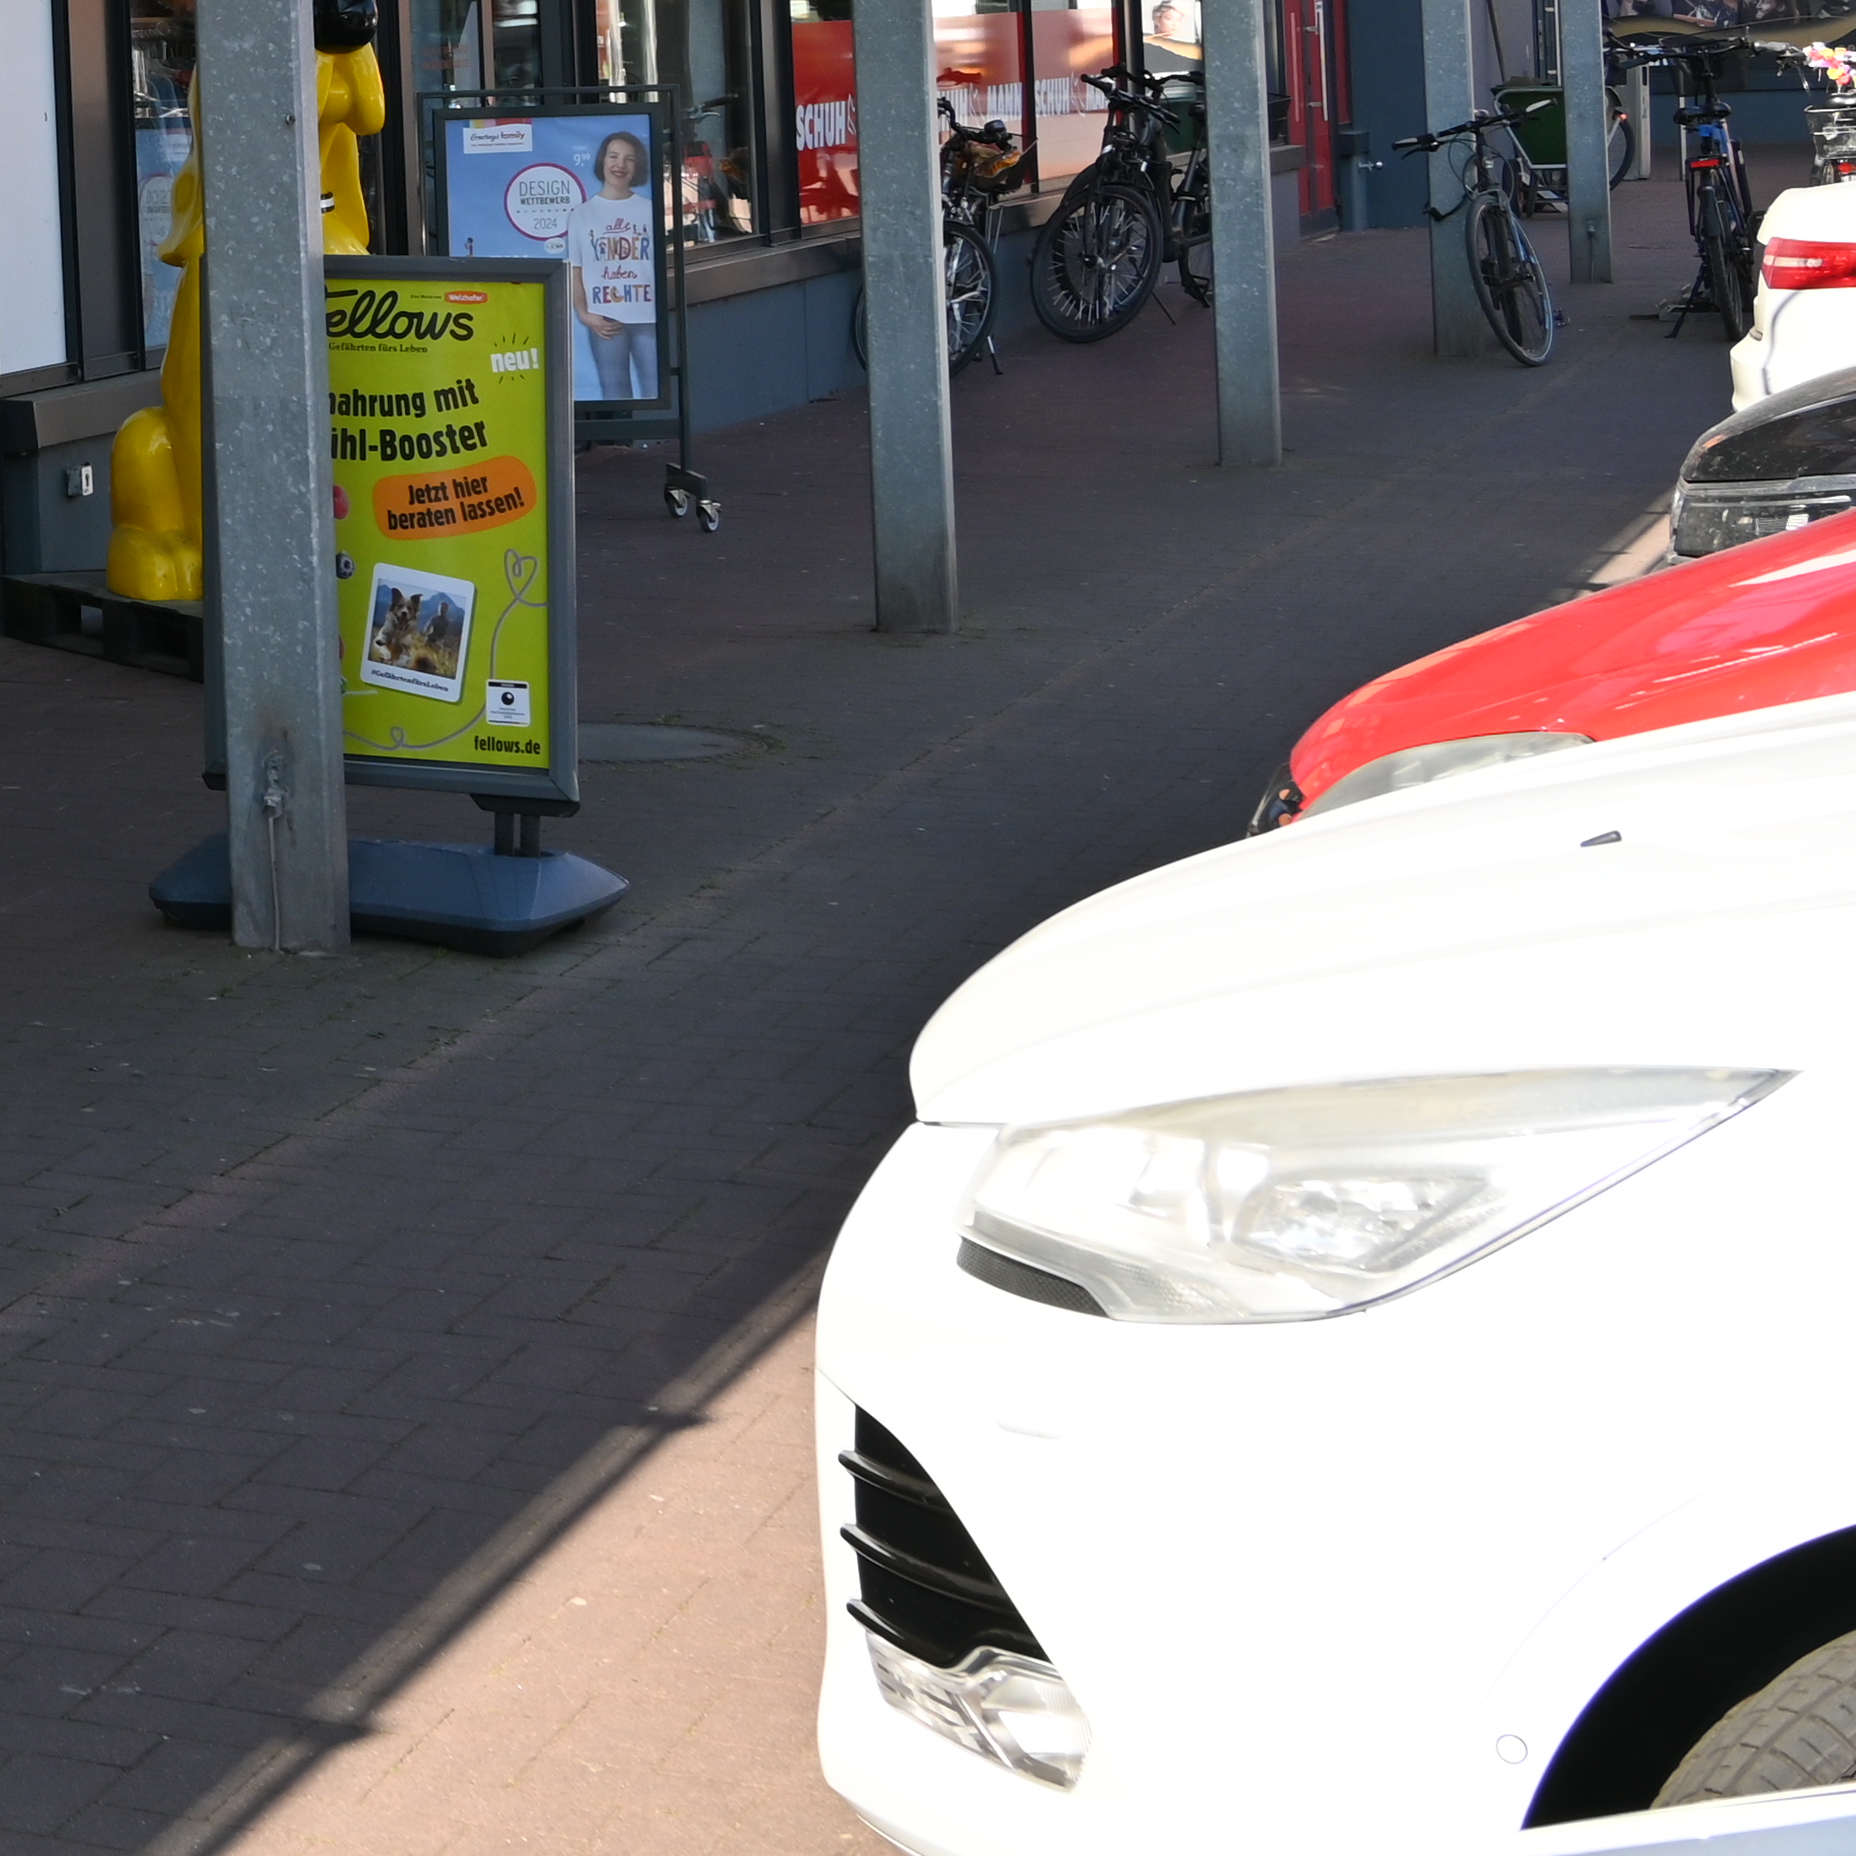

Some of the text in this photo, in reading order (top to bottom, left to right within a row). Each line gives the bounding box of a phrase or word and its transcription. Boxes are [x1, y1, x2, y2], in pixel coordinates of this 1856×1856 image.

[987, 83, 1023, 123] MANN
[1035, 77, 1070, 118] SCHUH
[796, 100, 846, 152] SCHUH
[519, 180, 570, 197] DESIGN
[520, 196, 571, 206] WETTBEWERB
[533, 218, 558, 230] 2024
[605, 217, 631, 231] alle
[601, 265, 638, 280] haben
[592, 284, 652, 304] RECHTE
[378, 343, 398, 353] fürs
[399, 344, 428, 353] Leben
[490, 347, 540, 373] neu!
[433, 377, 480, 413] mit
[408, 475, 489, 505] Jetzt hier
[387, 486, 525, 530] beraten lassen!
[474, 735, 541, 755] fellows.de
